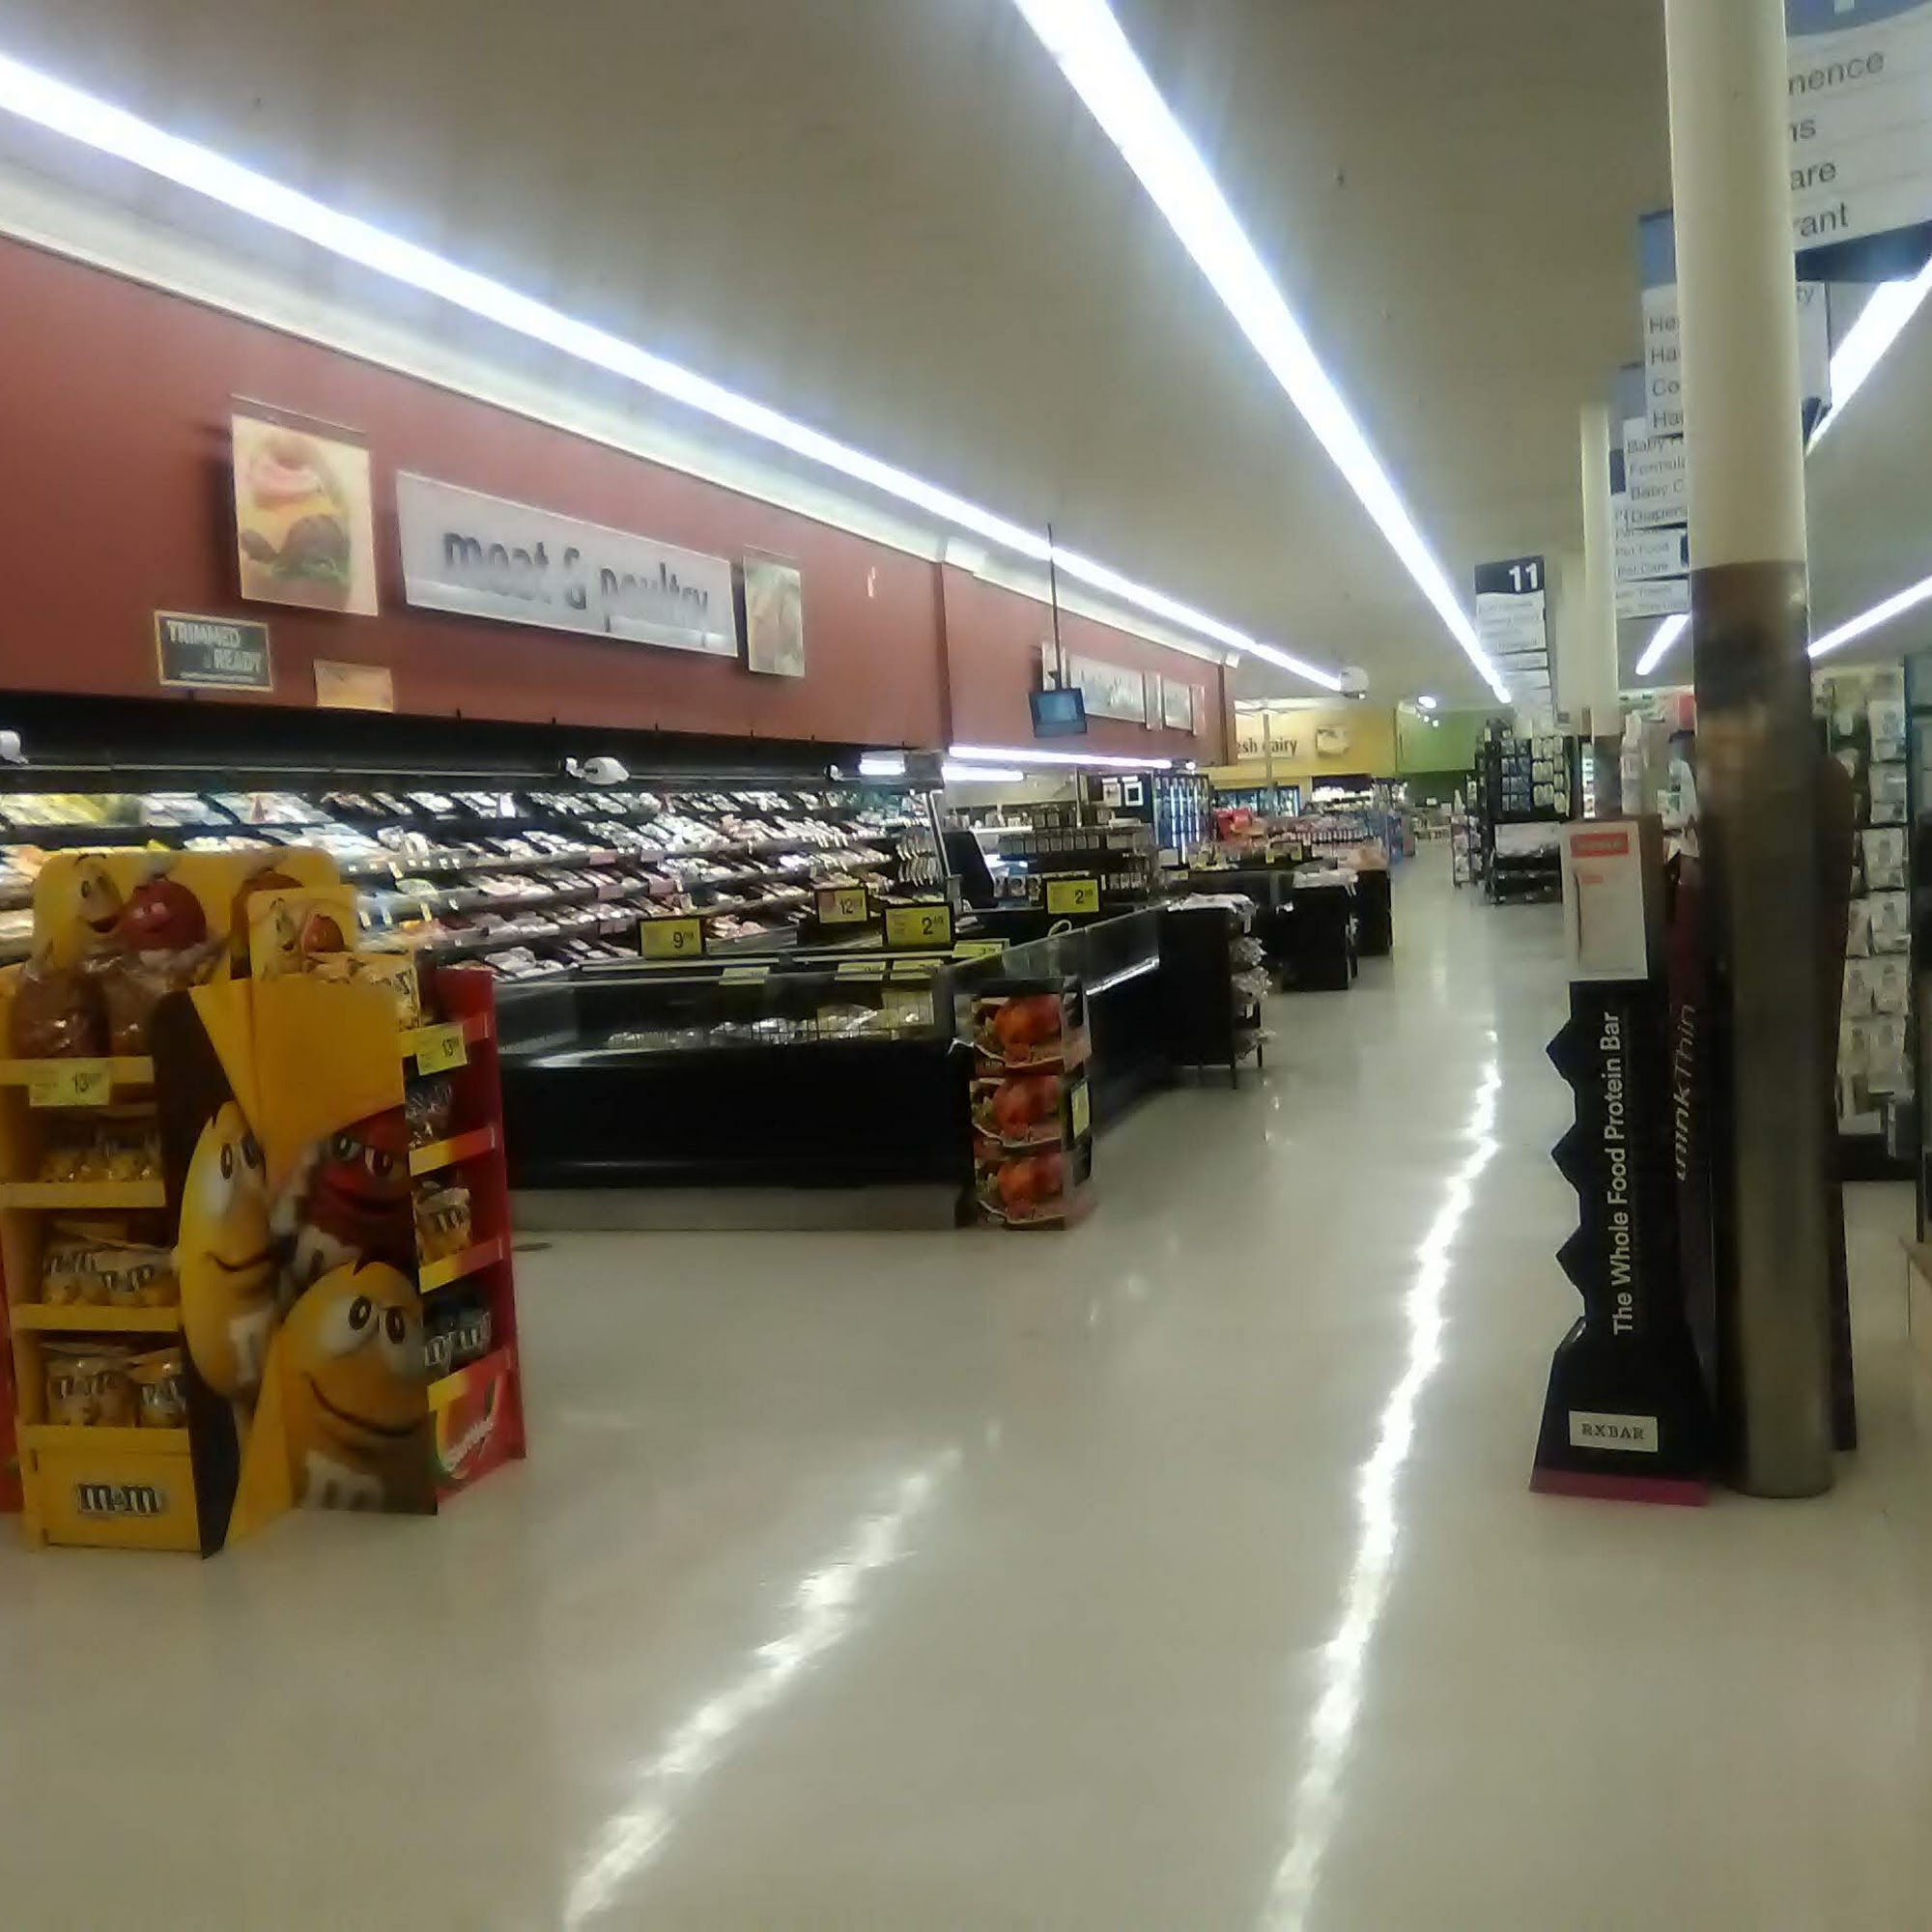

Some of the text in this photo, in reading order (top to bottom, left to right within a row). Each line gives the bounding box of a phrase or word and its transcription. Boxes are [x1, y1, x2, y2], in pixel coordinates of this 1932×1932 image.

[1508, 562, 1539, 592] 11
[1599, 1010, 1634, 1337] The Whole Food Protein Bar
